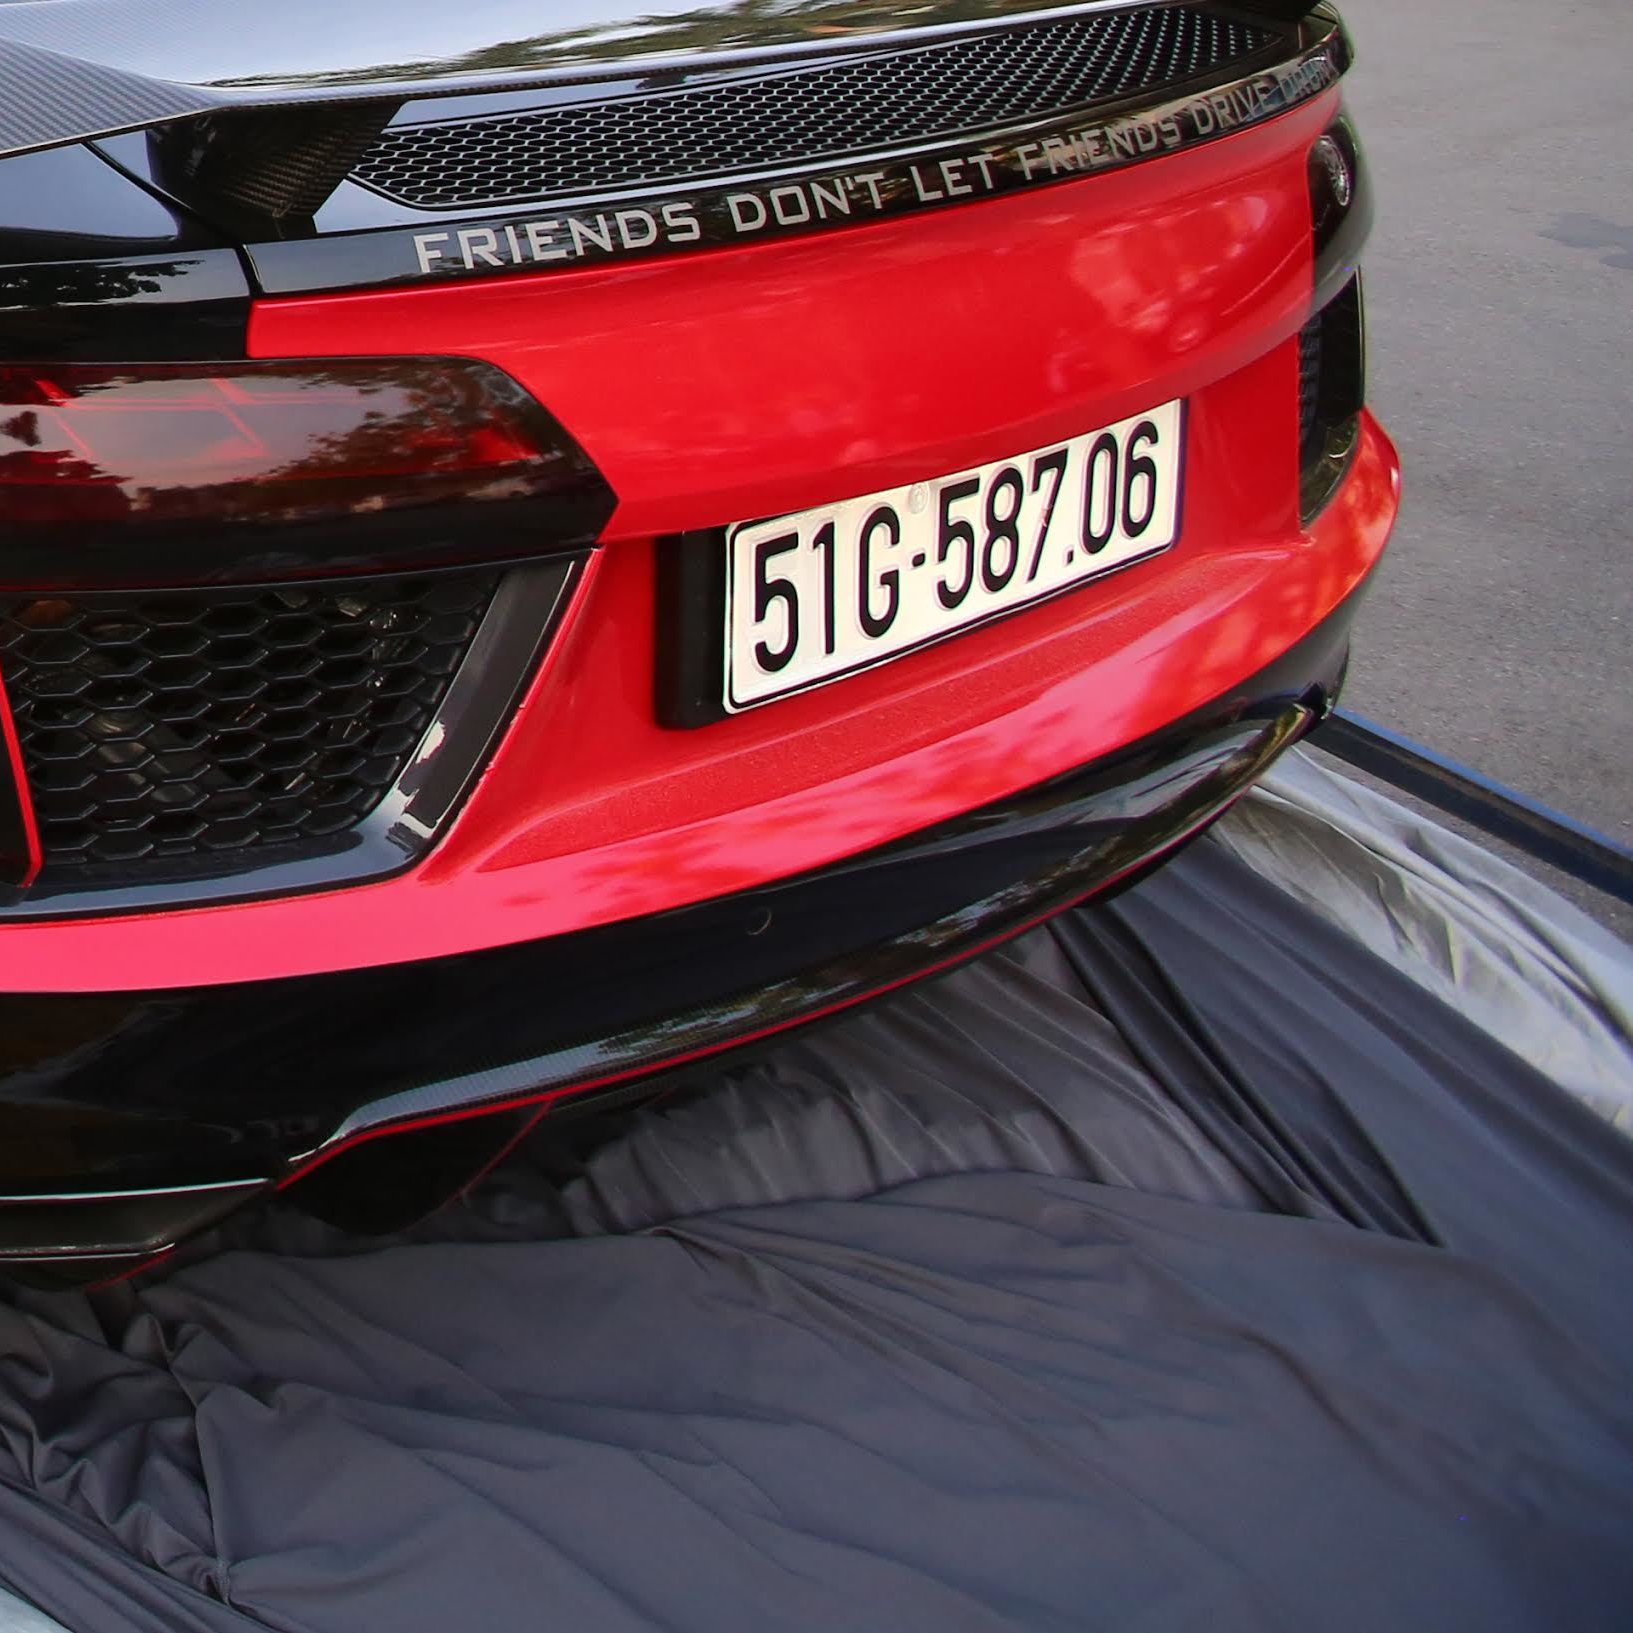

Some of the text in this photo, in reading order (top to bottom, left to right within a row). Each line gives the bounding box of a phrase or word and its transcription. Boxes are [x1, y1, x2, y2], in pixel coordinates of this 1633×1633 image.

[413, 202, 701, 273] FRIENDS
[726, 172, 885, 233] DON'T
[910, 153, 994, 202] LET
[1014, 116, 1182, 180] FRIENDS
[1190, 82, 1275, 135] DRIVE
[753, 420, 1159, 673] 51G-587.06
